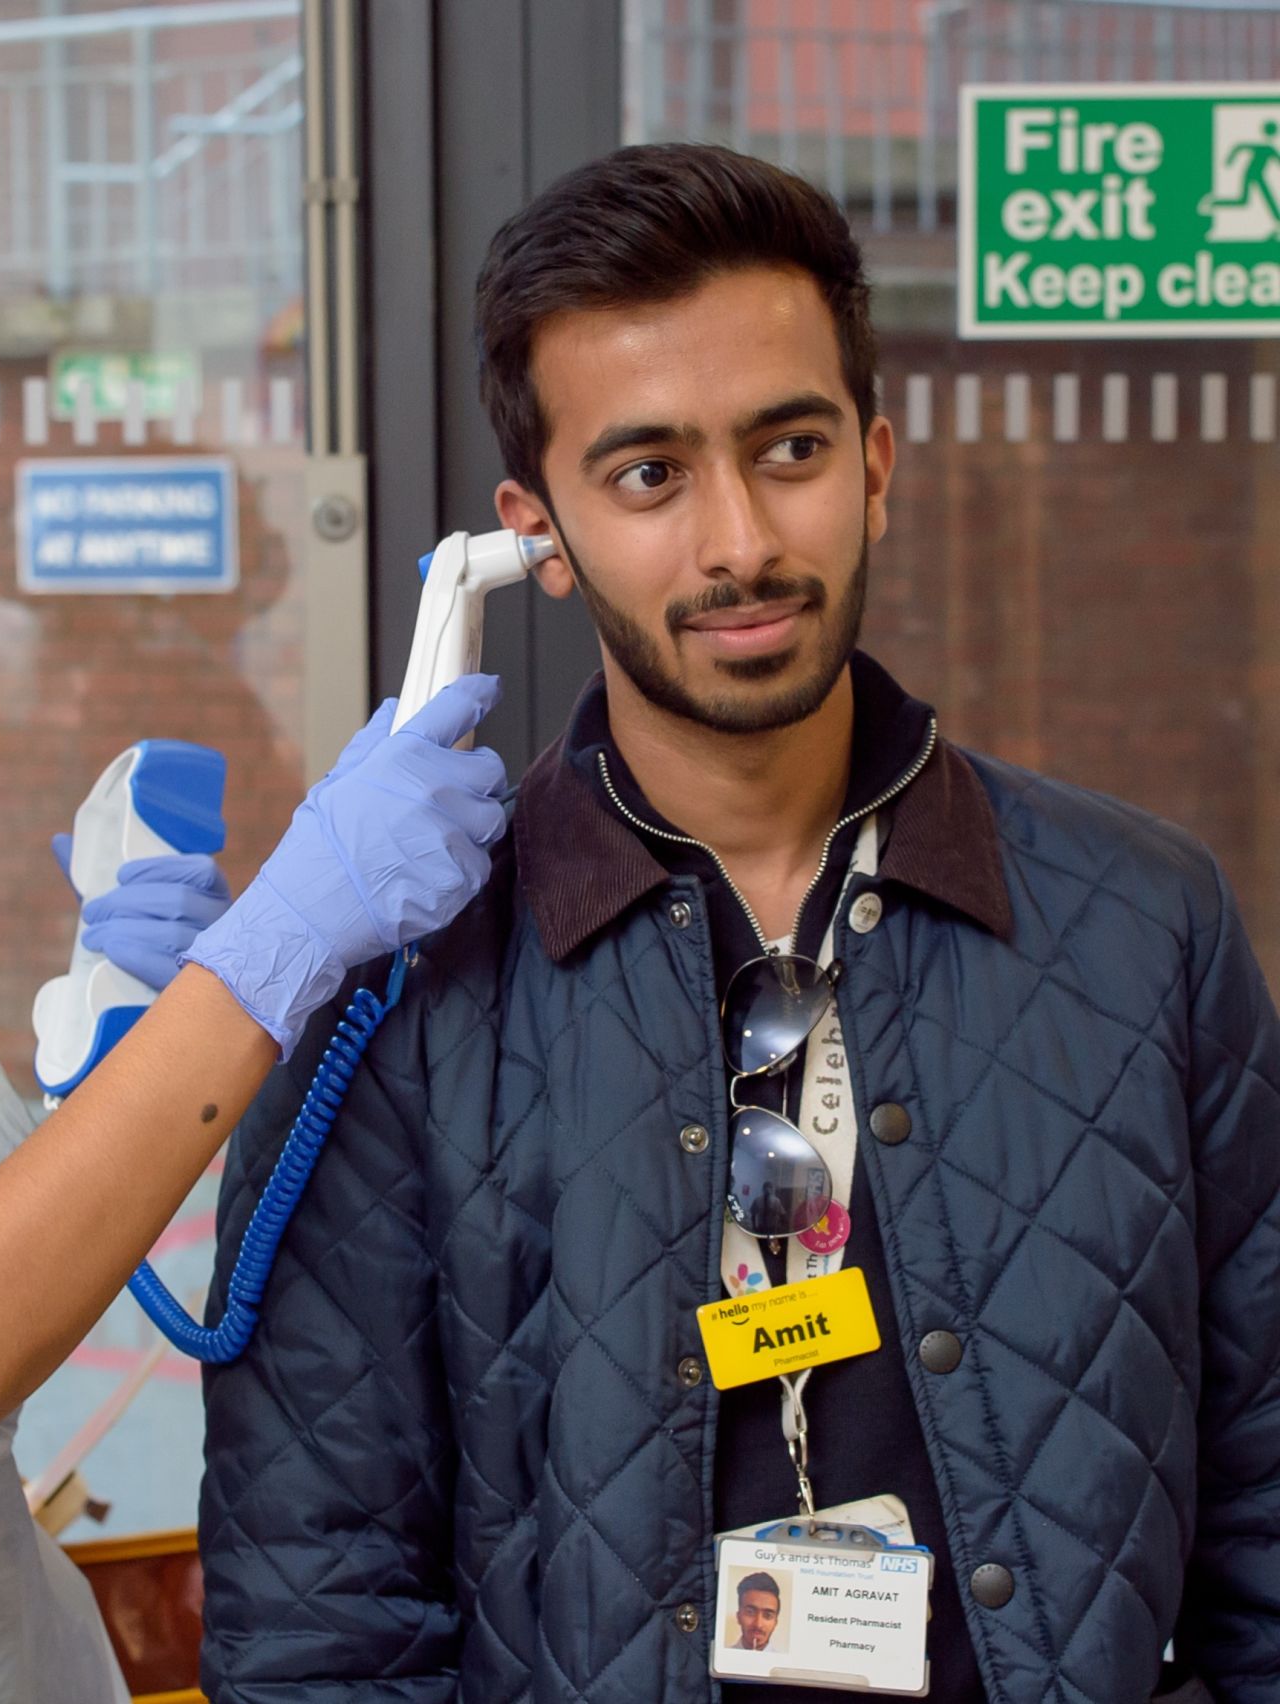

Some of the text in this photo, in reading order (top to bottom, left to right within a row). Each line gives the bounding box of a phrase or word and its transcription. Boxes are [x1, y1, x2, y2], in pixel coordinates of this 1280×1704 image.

[1005, 107, 1163, 174] Fire
[1001, 173, 1156, 241] exit
[983, 250, 1280, 320] Keep clea
[751, 1302, 767, 1312] my
[769, 1293, 797, 1307] name
[753, 1312, 831, 1353] Amit
[773, 1349, 819, 1367] Pharmacist
[754, 1549, 786, 1563] Guy's
[788, 1552, 810, 1563] and
[813, 1554, 824, 1565] St
[882, 1556, 917, 1573] NHS
[812, 1586, 899, 1602] AMIT AGRAVAT
[807, 1613, 902, 1629] Resident Pharmacist
[829, 1639, 876, 1653] Pharmacy
